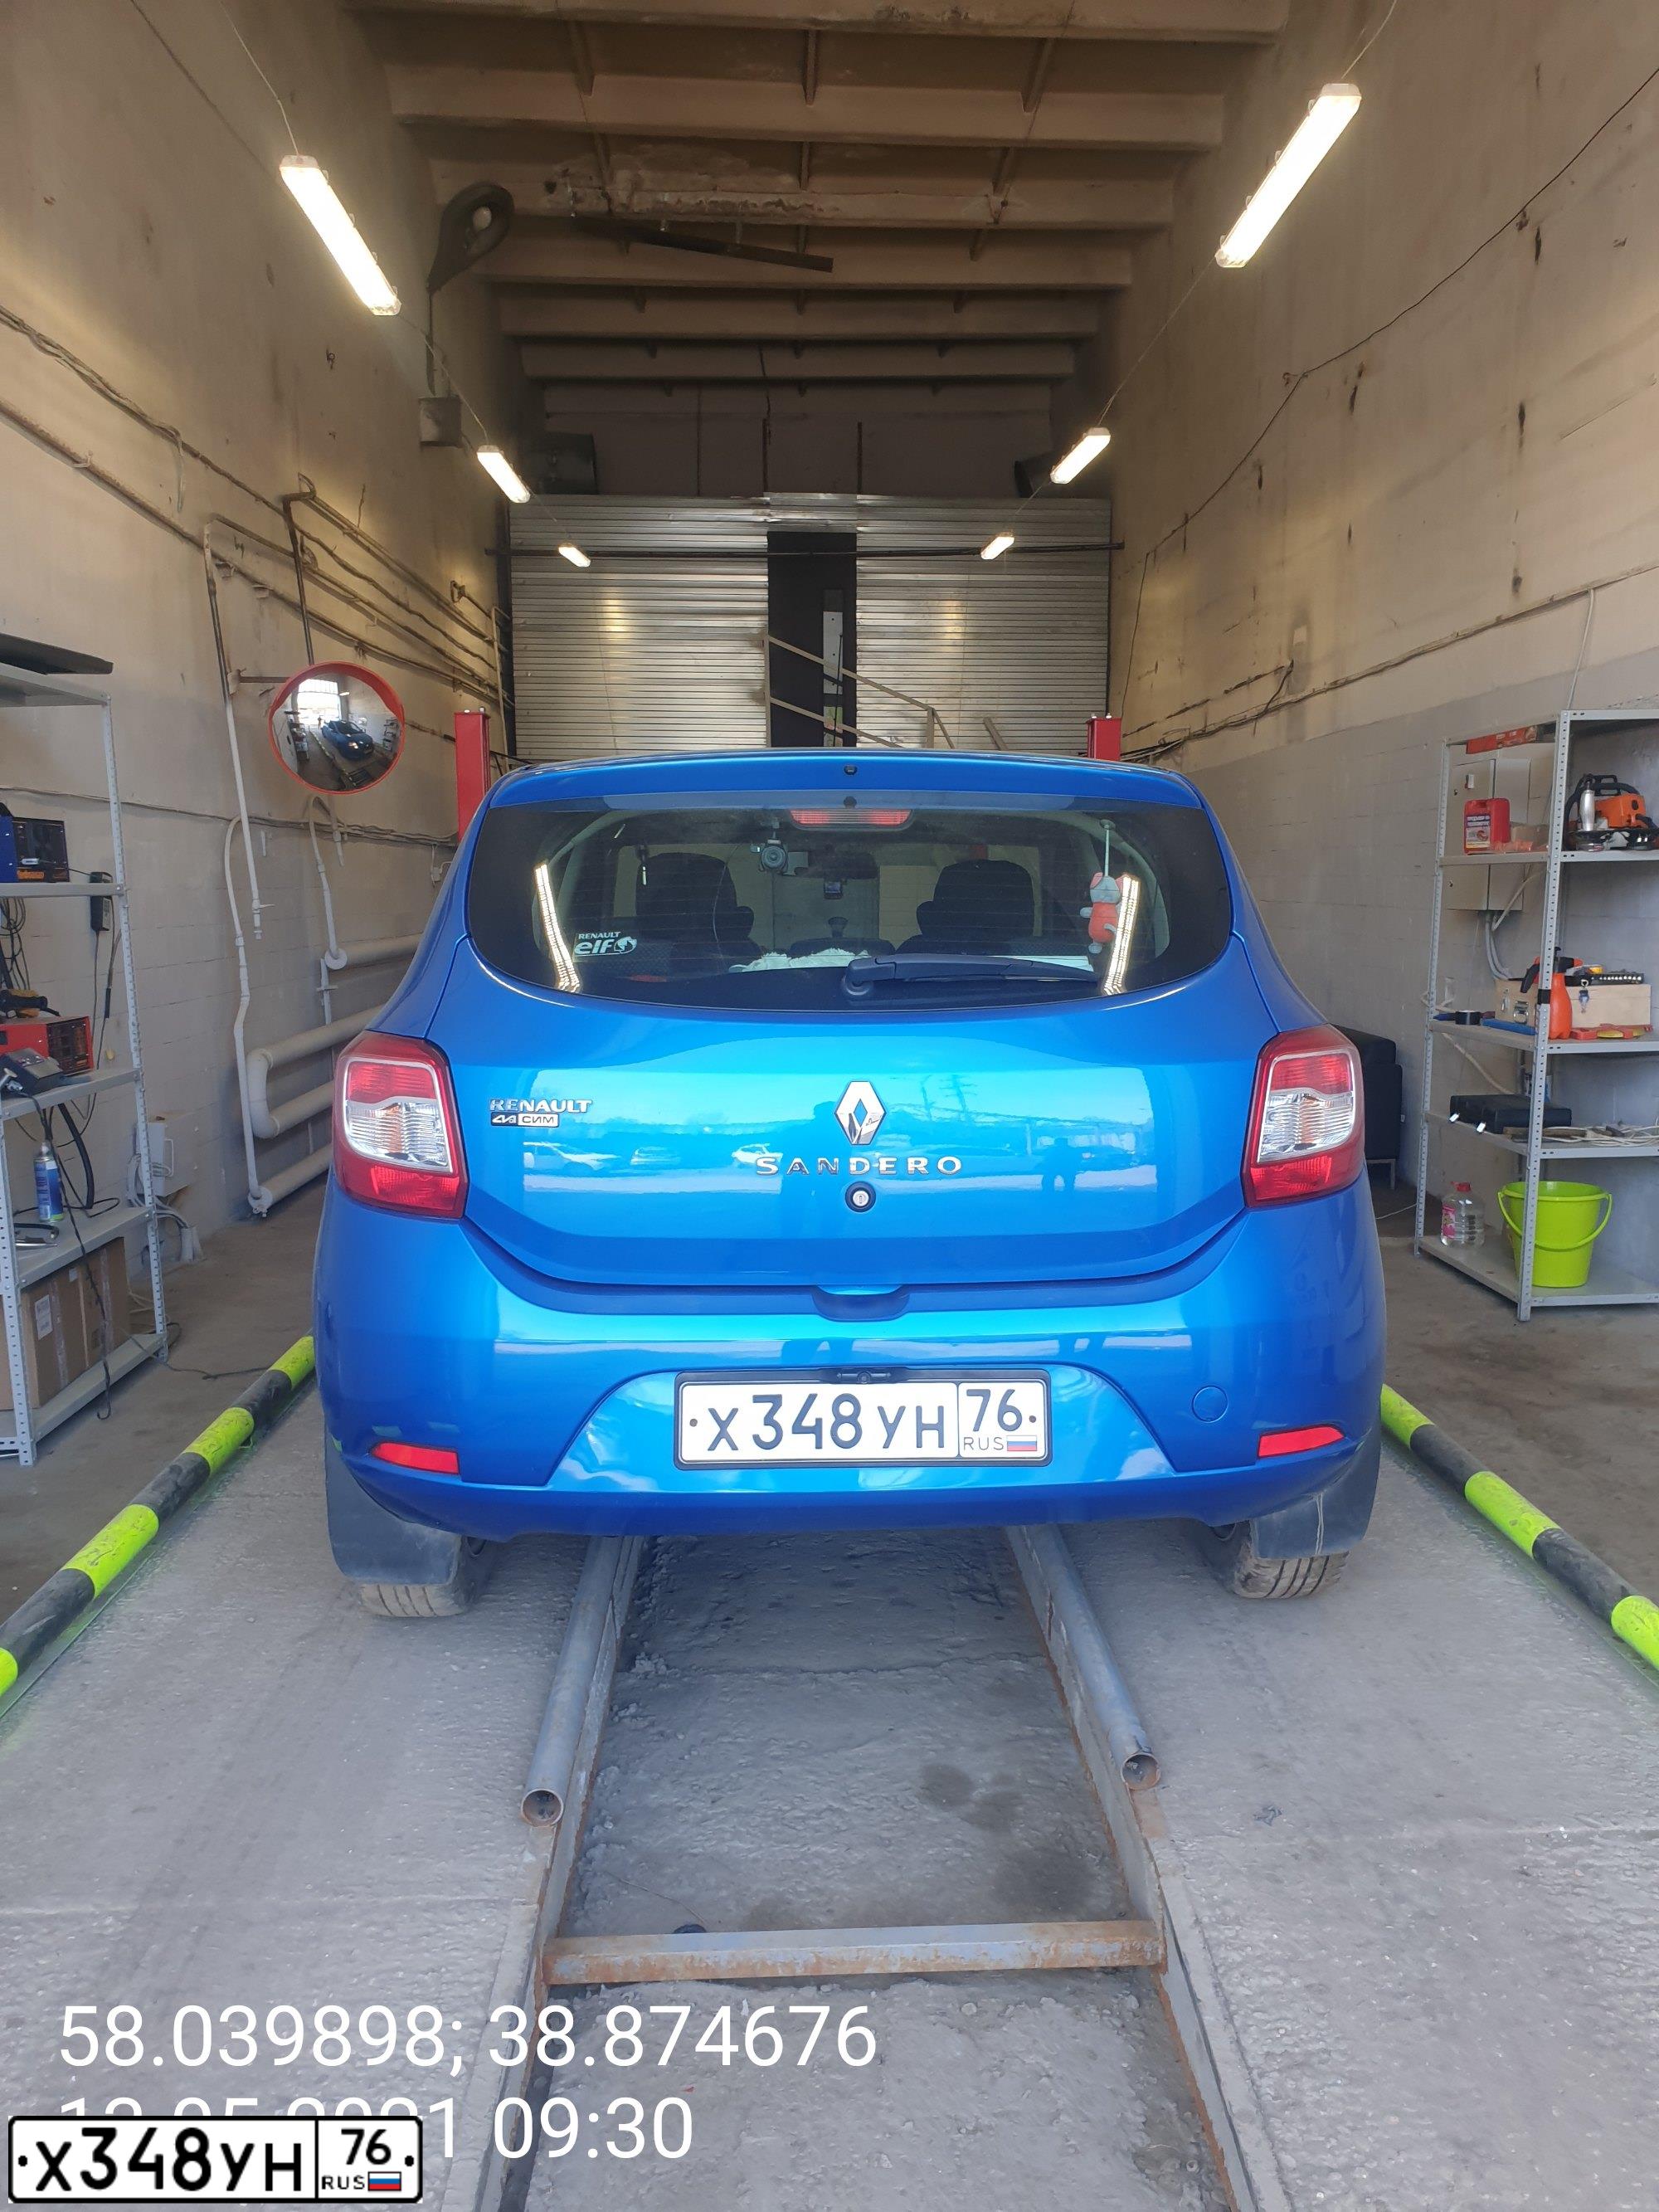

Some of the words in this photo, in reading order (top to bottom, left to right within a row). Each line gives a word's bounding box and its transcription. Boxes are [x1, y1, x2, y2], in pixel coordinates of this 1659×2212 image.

[578, 931, 620, 939] RENAULT
[574, 939, 615, 954] elf
[489, 1099, 592, 1113] RENAULT
[757, 1156, 962, 1175] SANDERO
[966, 1389, 1023, 1432] 76
[964, 1437, 1004, 1451] RUS
